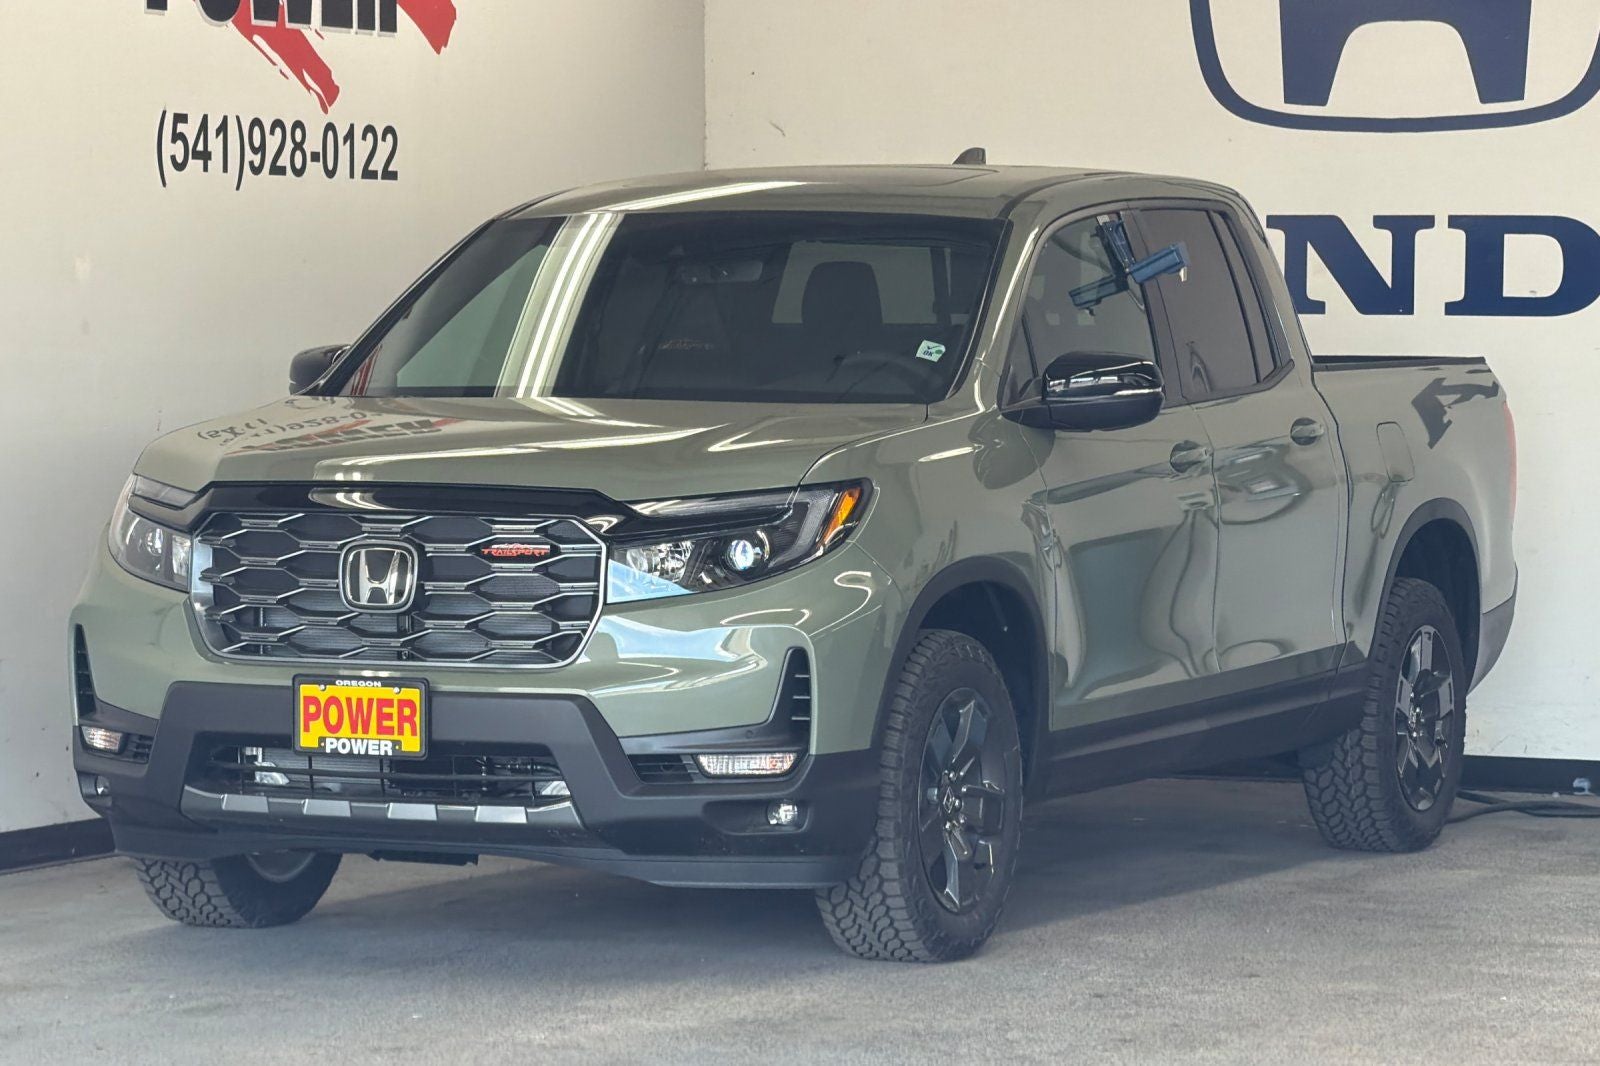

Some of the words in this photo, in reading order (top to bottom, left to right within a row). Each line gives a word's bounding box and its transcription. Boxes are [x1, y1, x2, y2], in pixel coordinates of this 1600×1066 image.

[156, 108, 399, 191] (541)928-0122
[335, 679, 382, 688] OREGON
[302, 695, 418, 737] POWER
[325, 737, 393, 756] POWER
